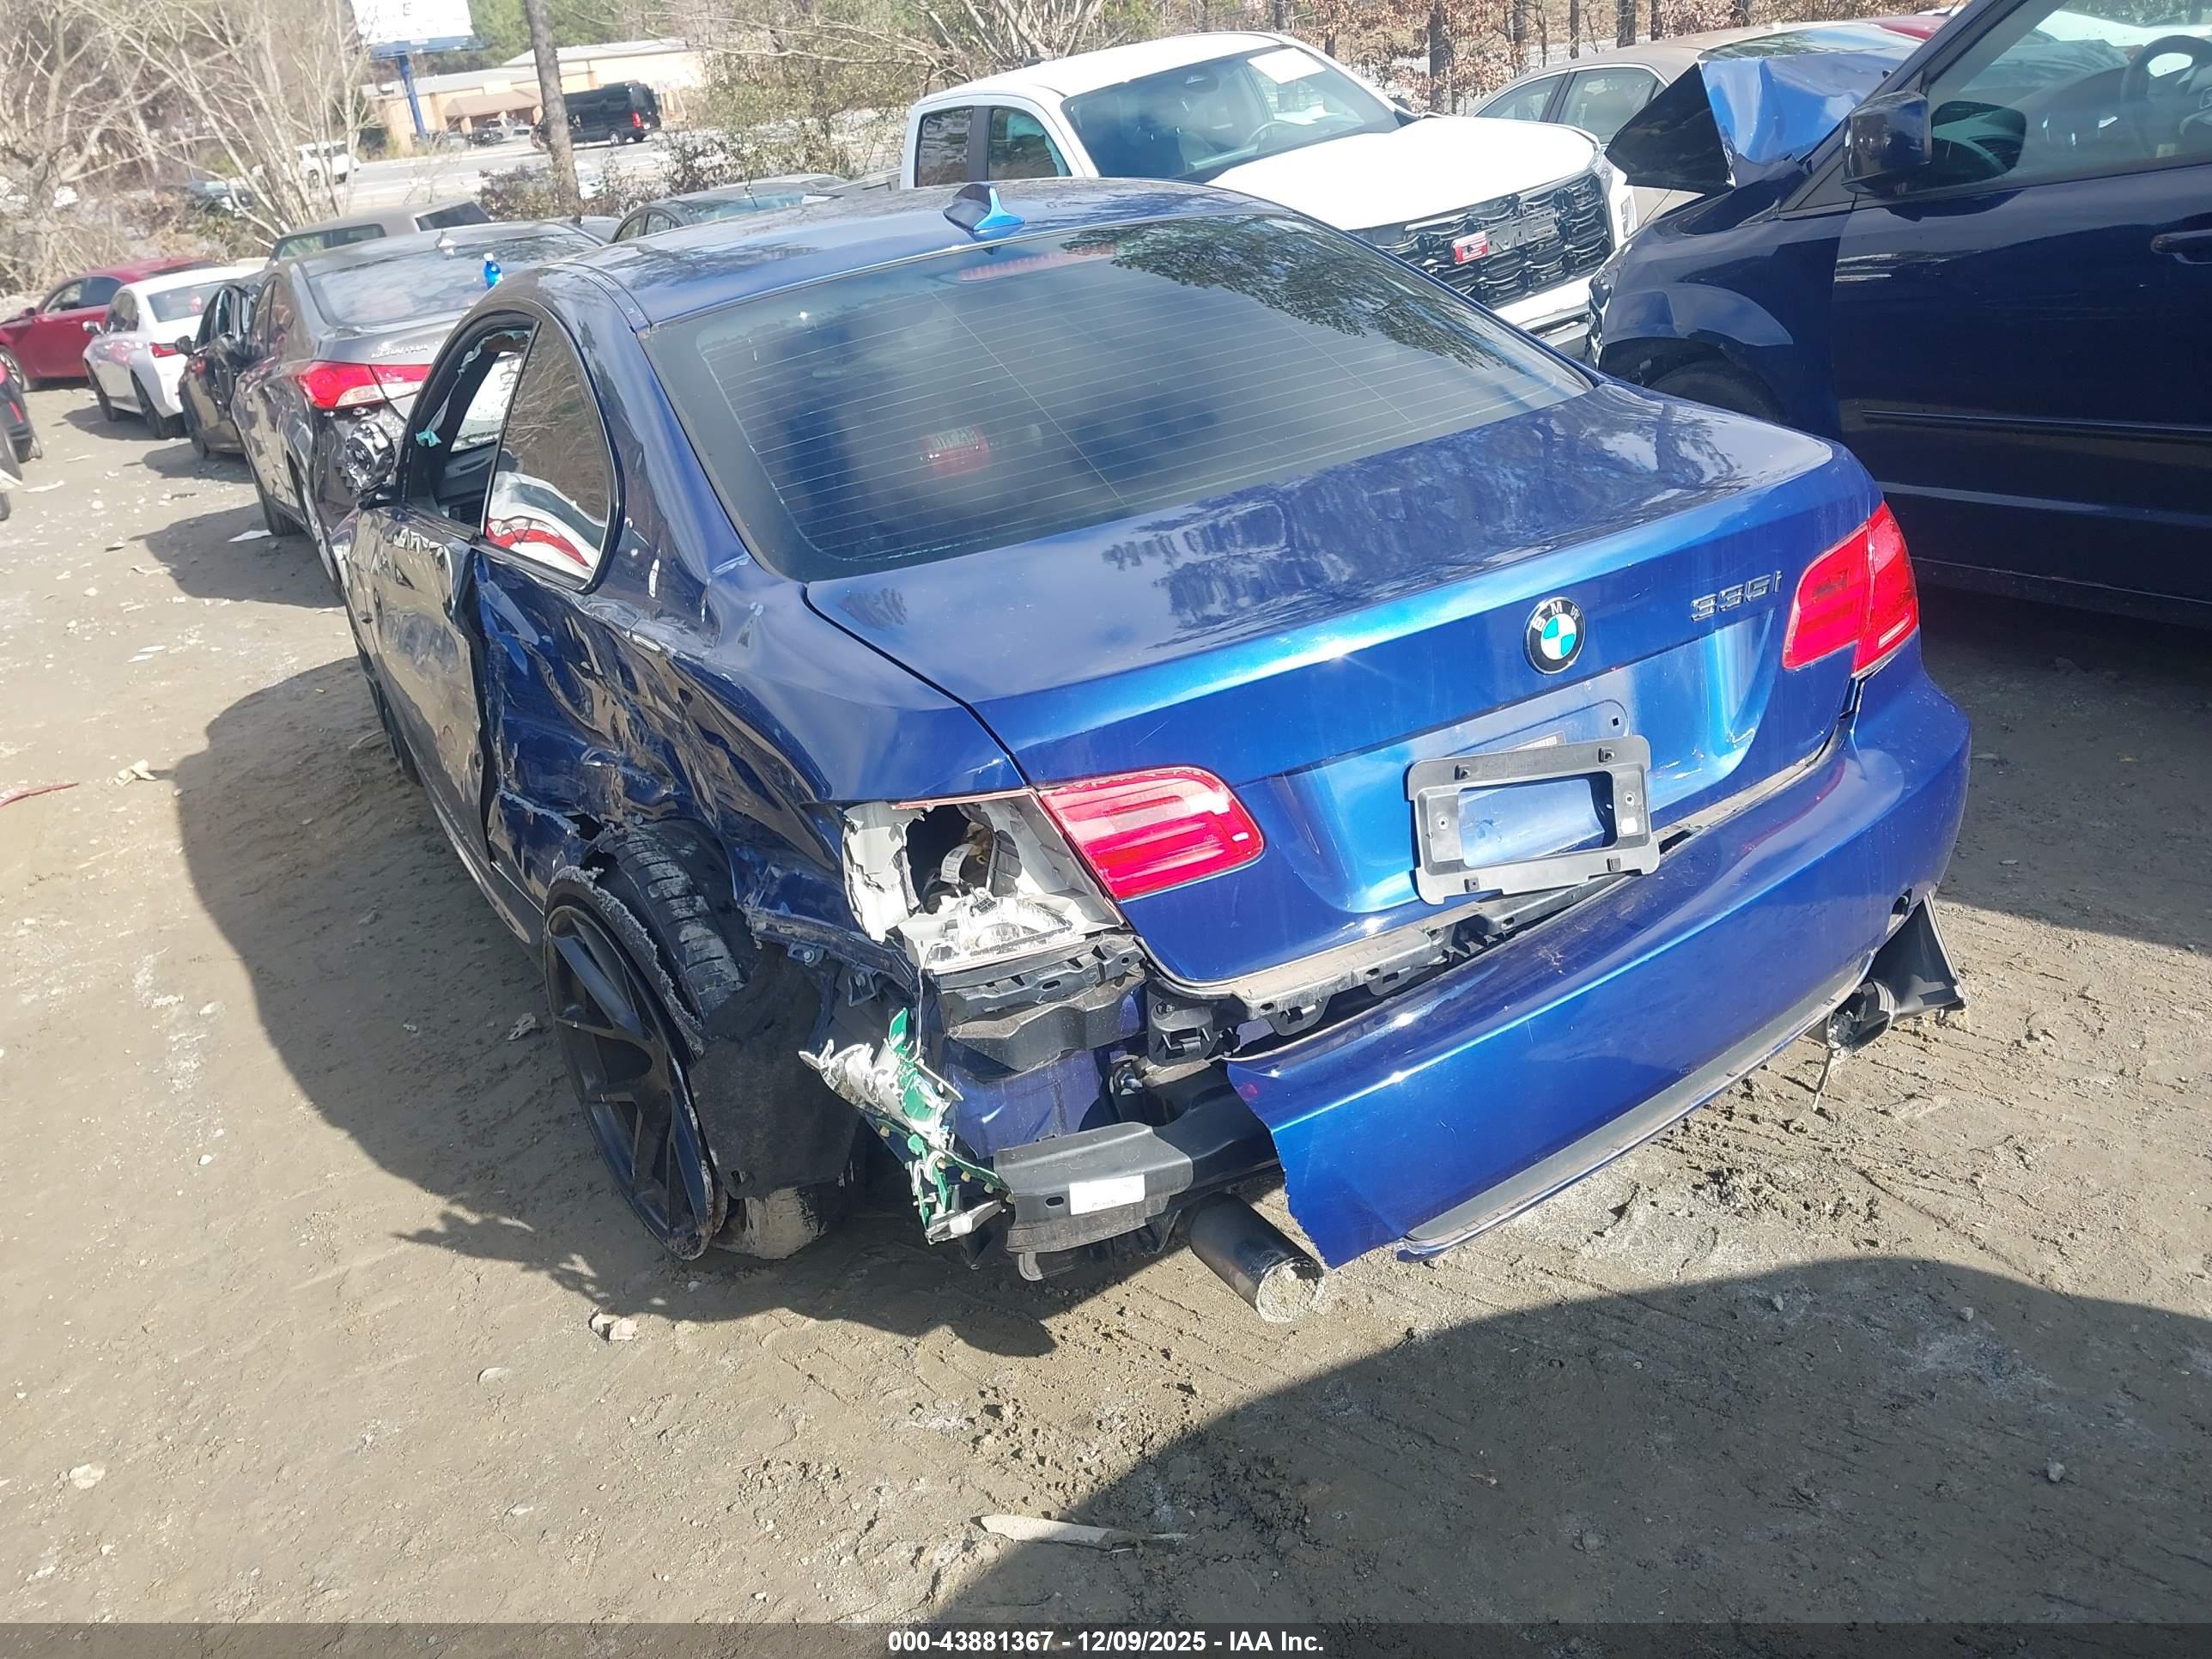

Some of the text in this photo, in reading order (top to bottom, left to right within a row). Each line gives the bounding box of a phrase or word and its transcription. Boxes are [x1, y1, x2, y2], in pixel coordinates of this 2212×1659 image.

[1451, 207, 1557, 264] GMC
[1531, 600, 1581, 632] BMW
[1690, 570, 1784, 622] 335i
